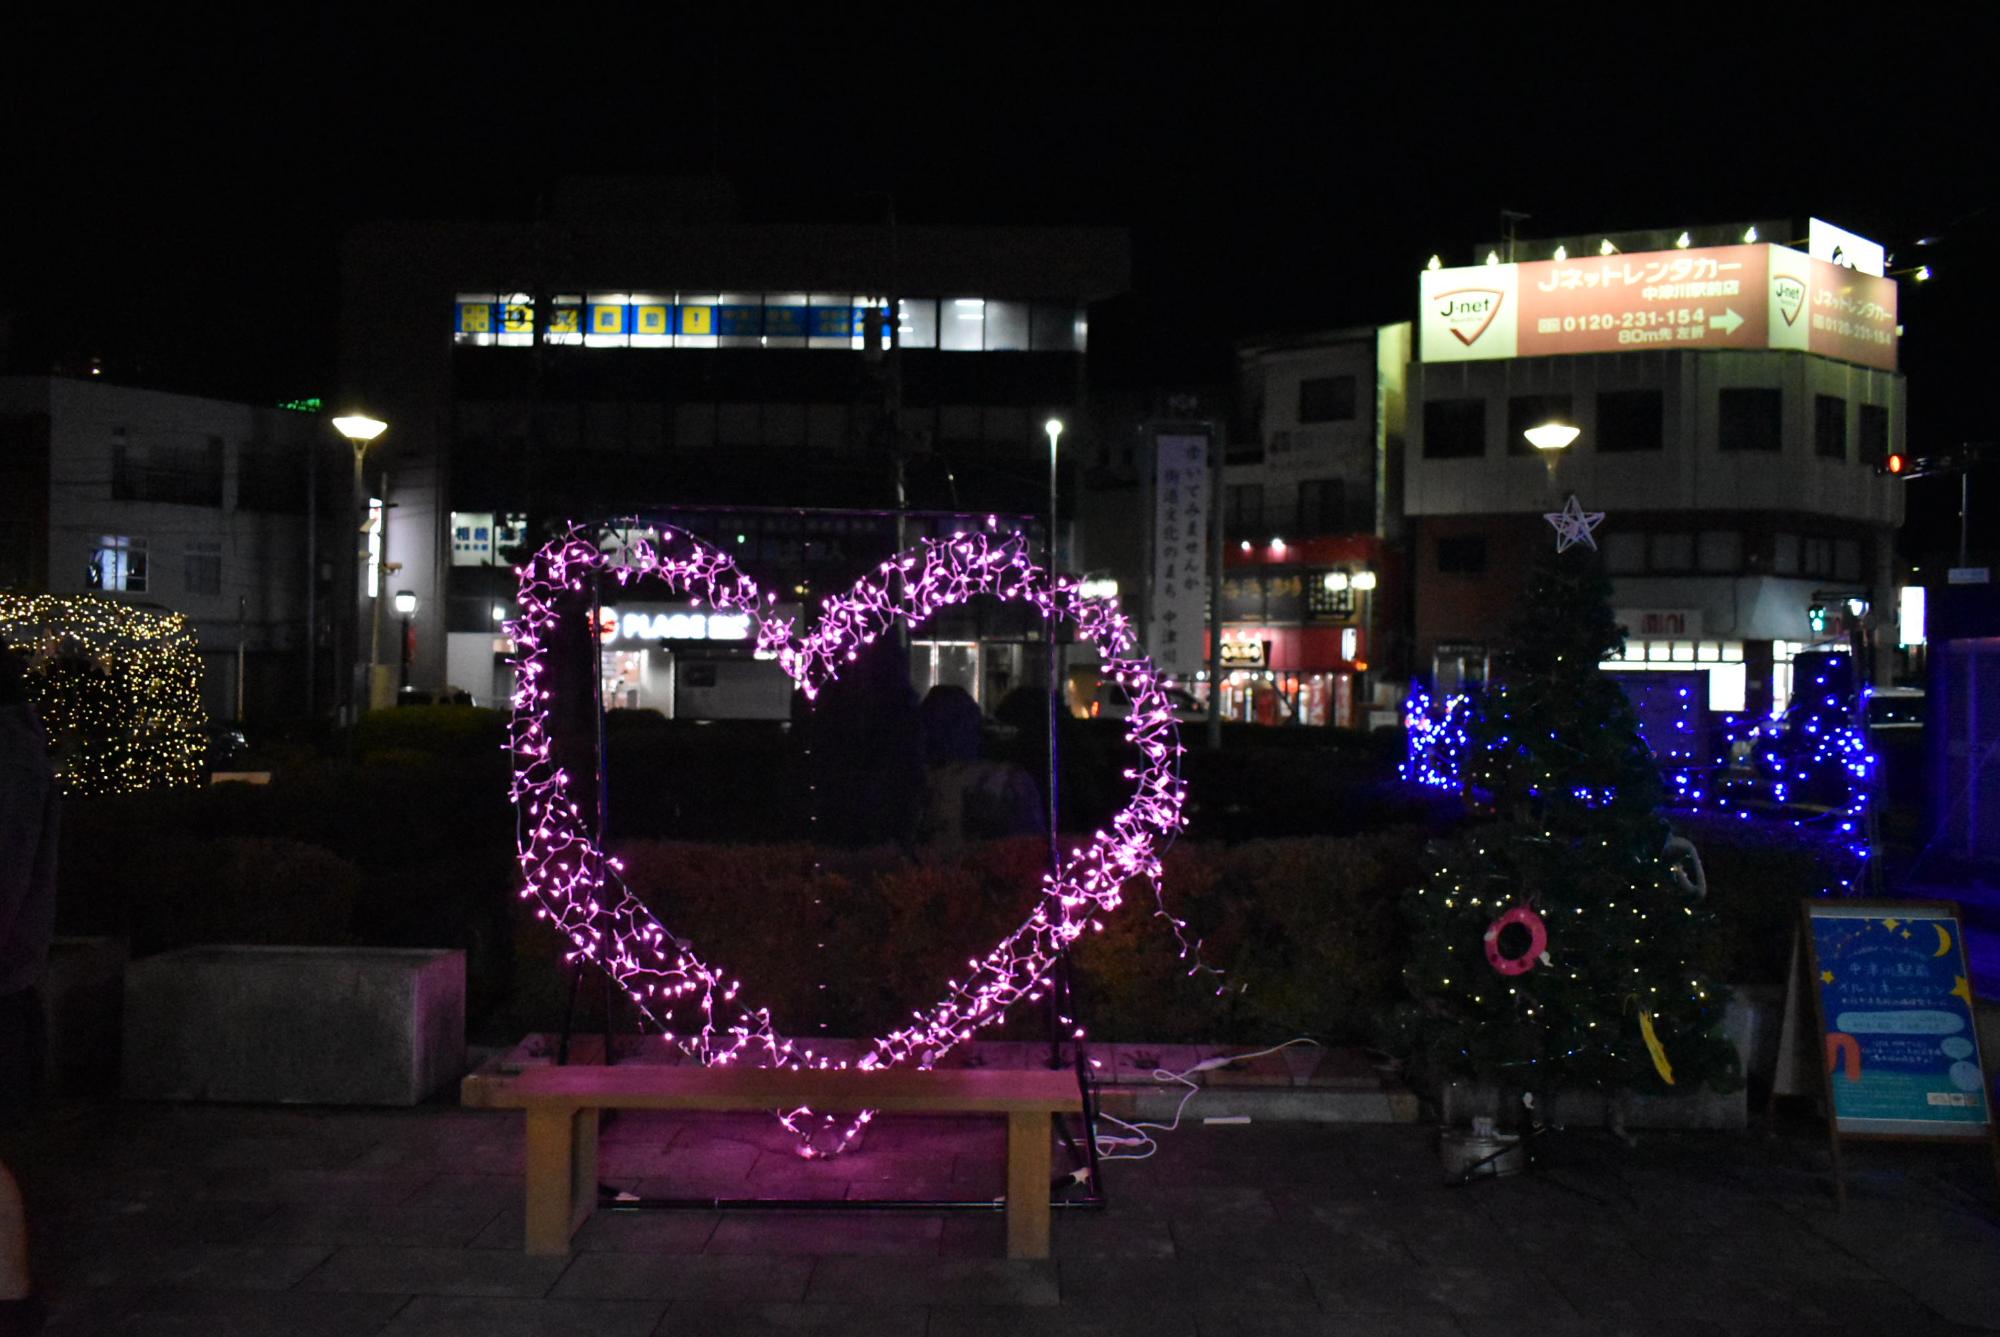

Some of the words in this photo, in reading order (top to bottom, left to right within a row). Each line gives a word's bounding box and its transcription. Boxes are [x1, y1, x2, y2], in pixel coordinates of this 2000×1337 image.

[1537, 258, 1743, 292] Jネットレンタカー
[1563, 308, 1705, 332] 0120-231-154
